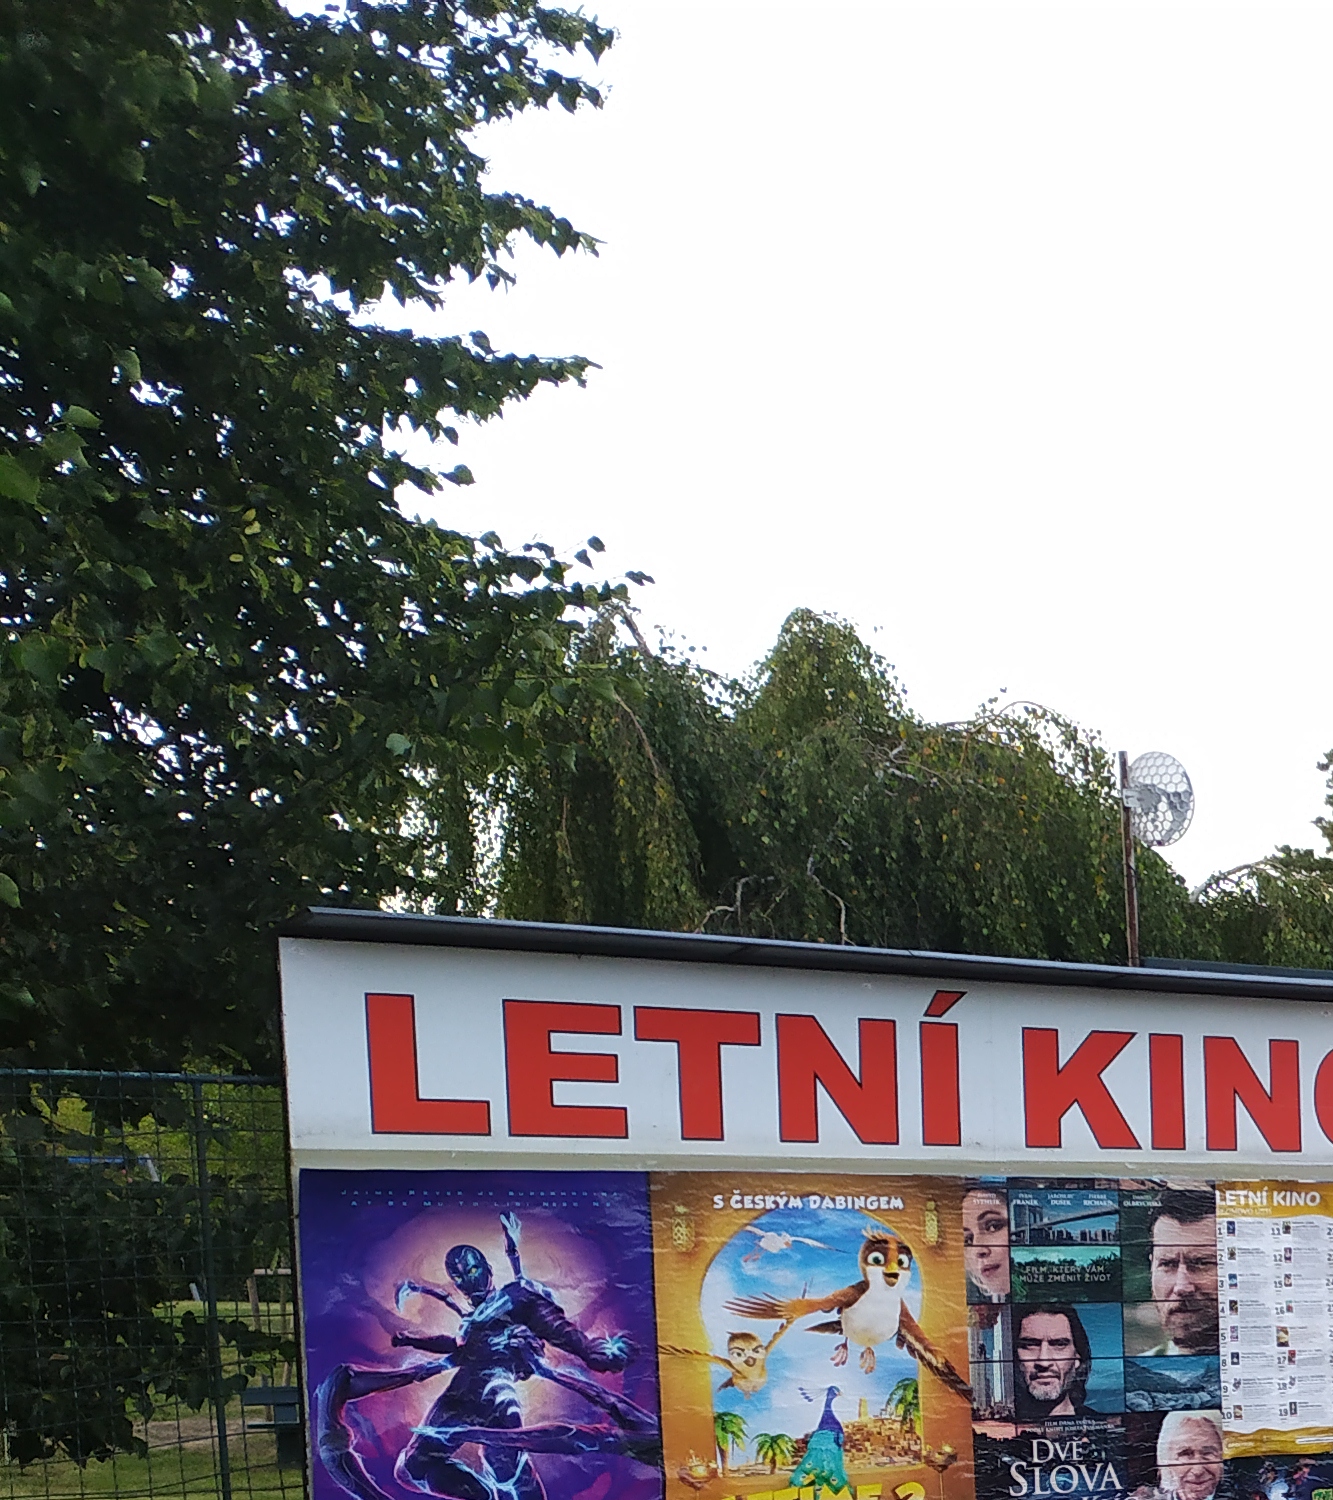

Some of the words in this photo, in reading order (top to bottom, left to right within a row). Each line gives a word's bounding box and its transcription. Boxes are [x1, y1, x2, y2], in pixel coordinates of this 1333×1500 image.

[364, 990, 967, 1146] LETNÍ
[713, 1194, 724, 1209] S
[730, 1189, 803, 1210] ČESKÝM
[809, 1195, 905, 1210] DABINGEM
[1216, 1186, 1268, 1206] LETNÍ
[1273, 1190, 1321, 1207] KINO
[1032, 1437, 1085, 1464] DVĚ
[1009, 1460, 1125, 1497] SLOVA
